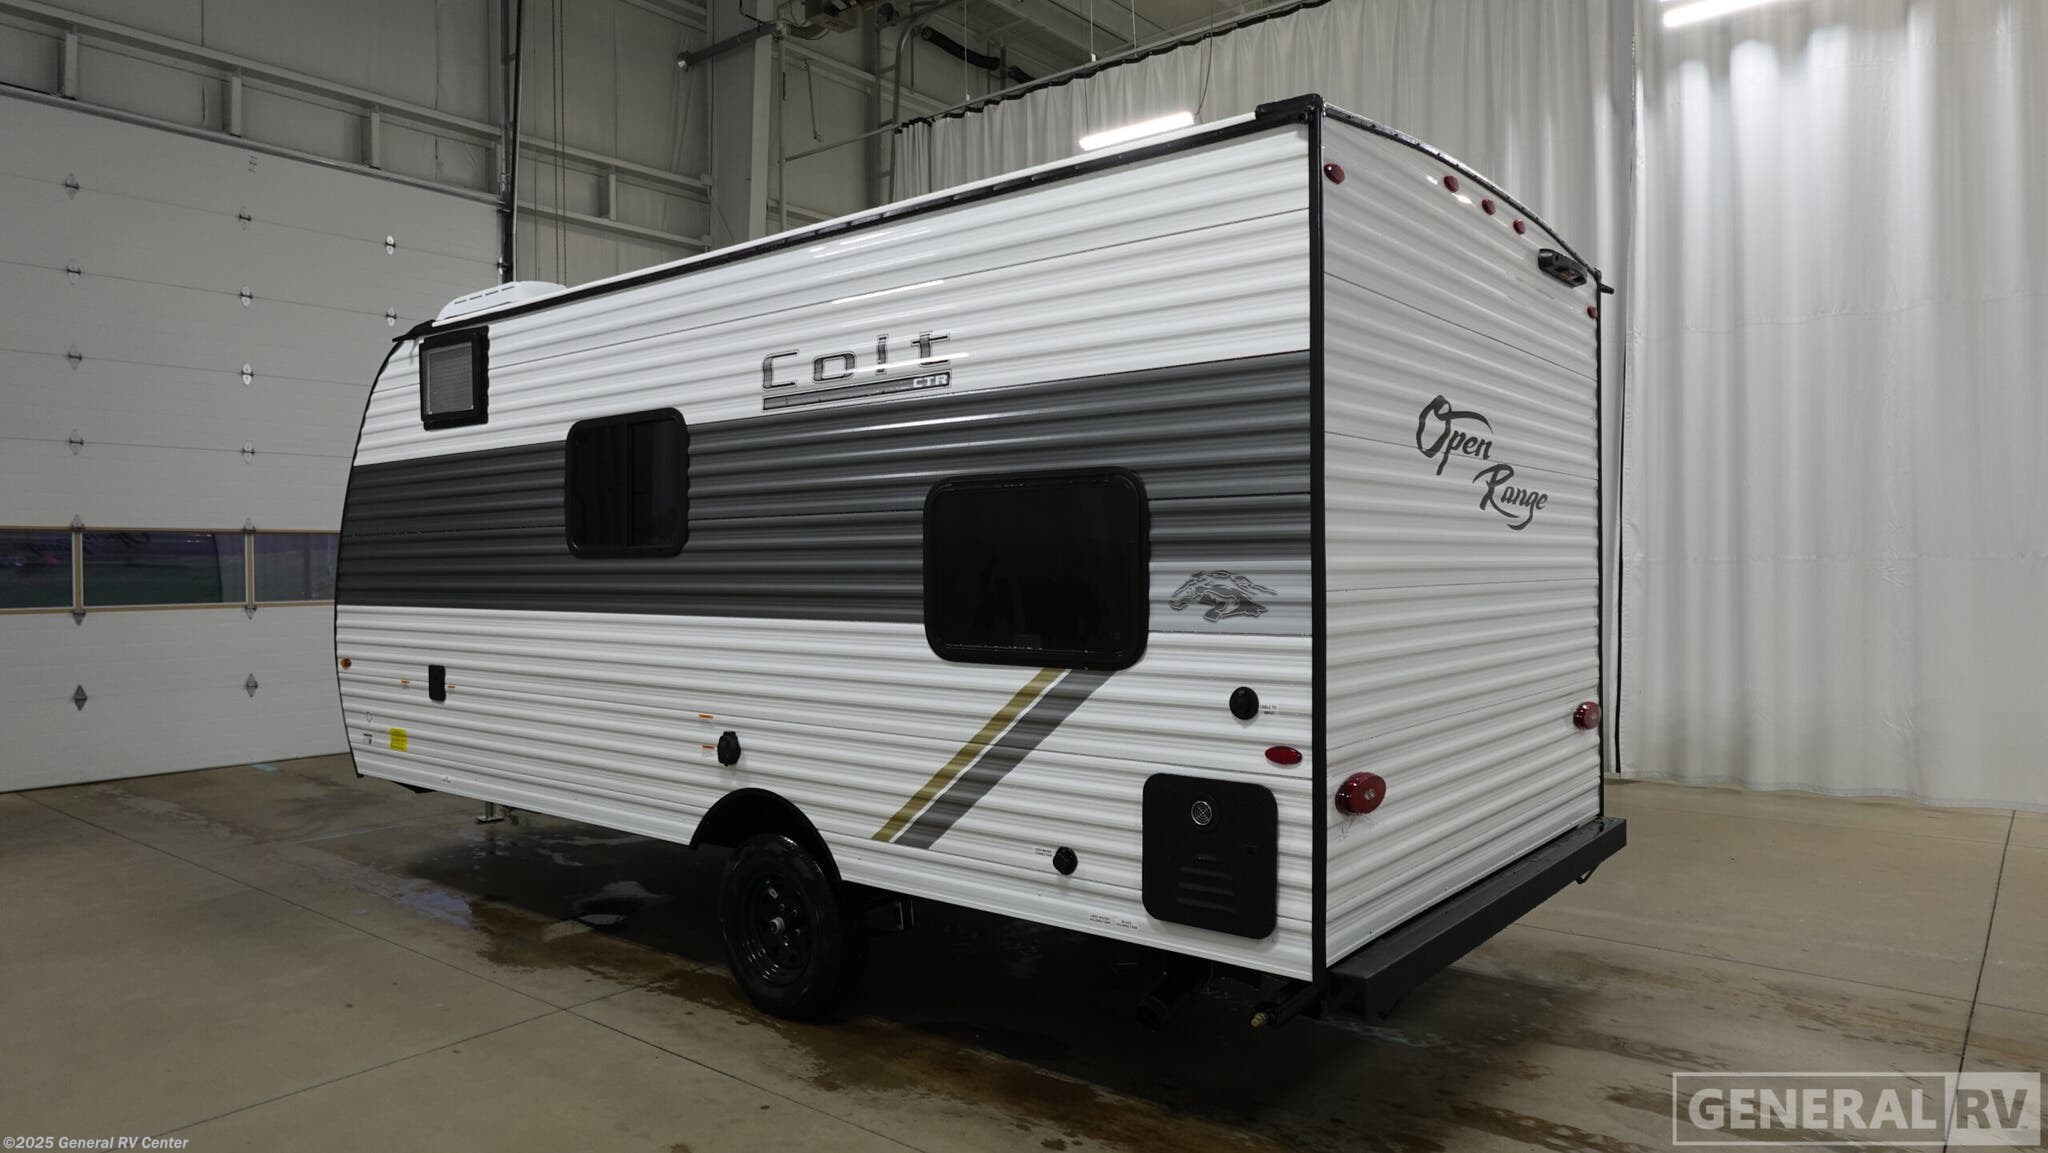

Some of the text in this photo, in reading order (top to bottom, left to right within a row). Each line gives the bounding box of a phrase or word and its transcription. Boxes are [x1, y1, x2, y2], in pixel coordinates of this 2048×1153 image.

[762, 331, 950, 390] Colt
[912, 374, 949, 389] CTR
[1416, 394, 1494, 476] Open
[1472, 463, 1549, 531] Range
